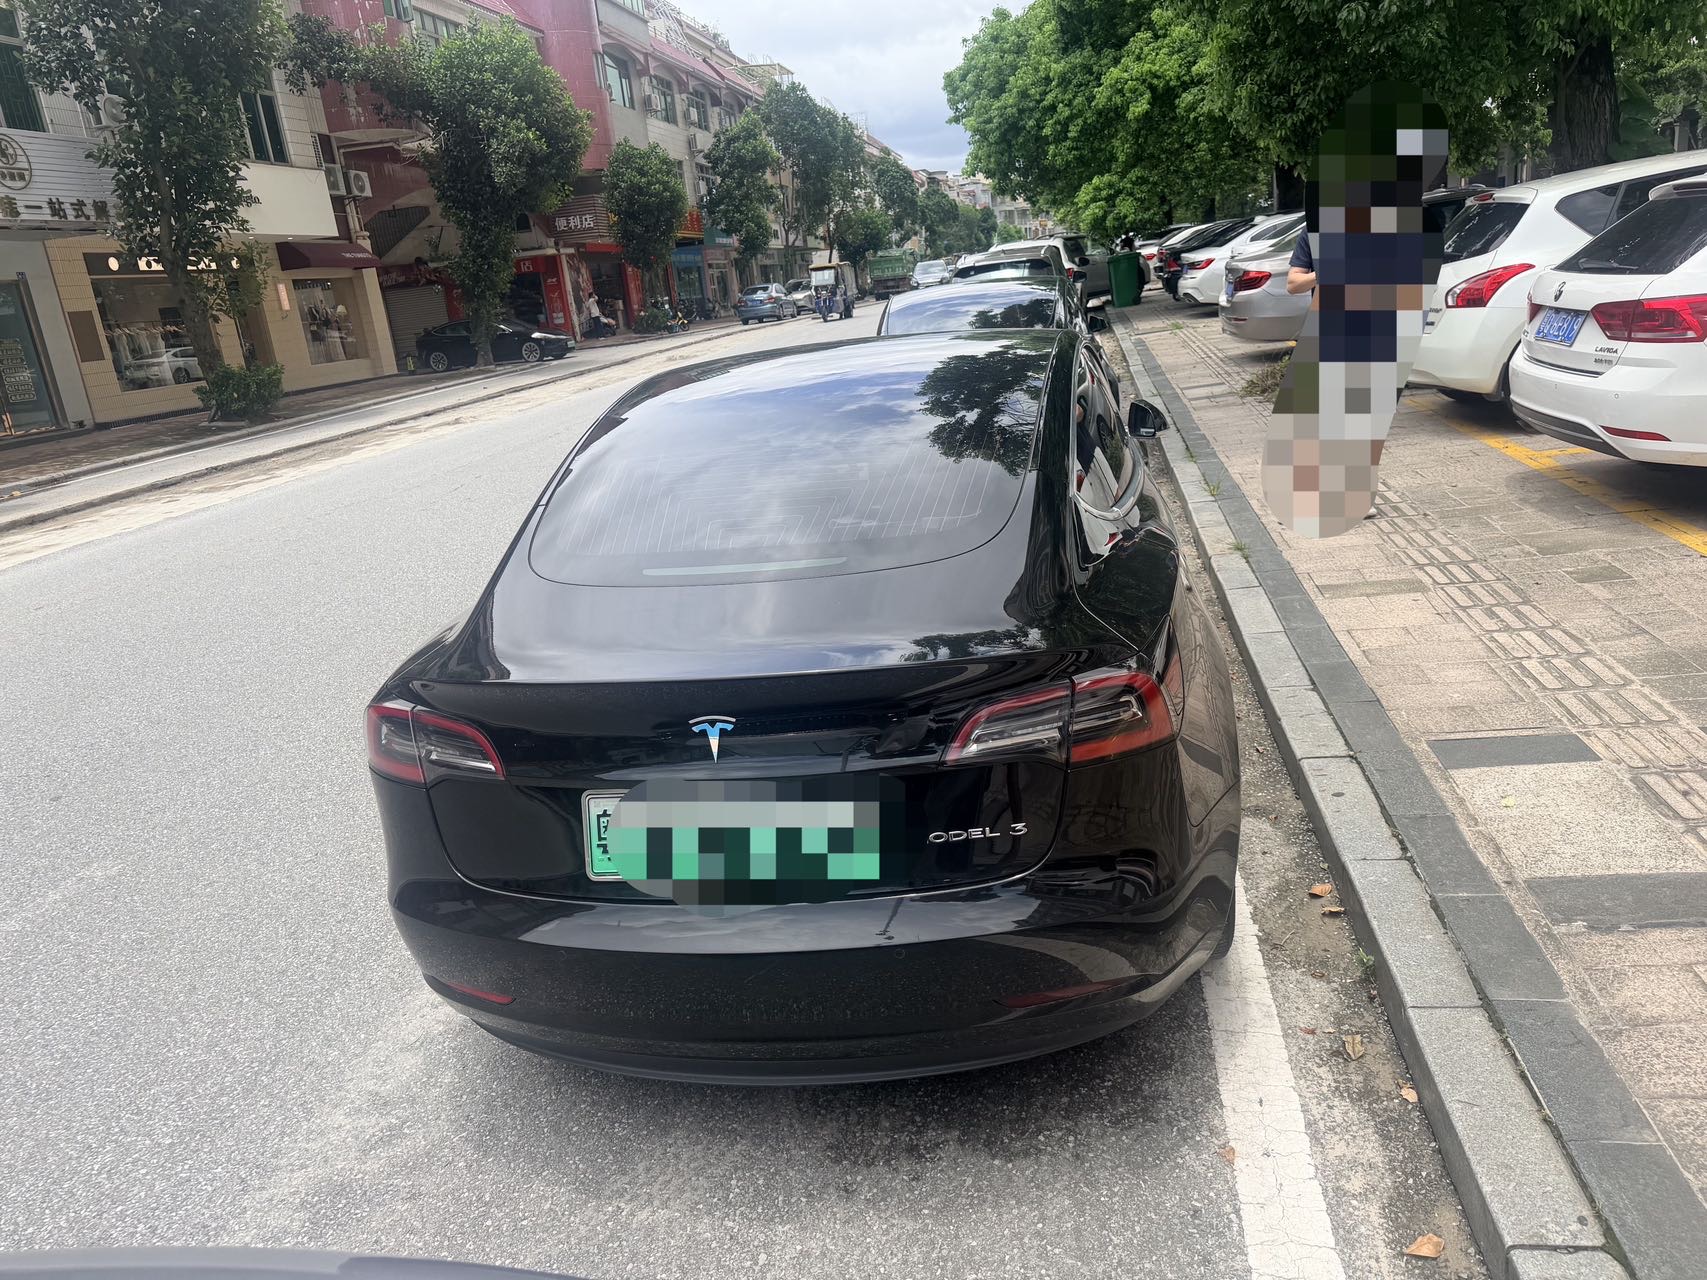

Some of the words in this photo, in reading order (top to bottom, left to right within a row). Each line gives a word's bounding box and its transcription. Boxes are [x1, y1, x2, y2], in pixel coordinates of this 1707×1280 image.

[555, 214, 595, 231] 便利店
[1594, 346, 1619, 355] LAVIDA
[927, 827, 1000, 843] ODEL
[1009, 822, 1028, 836] 3
